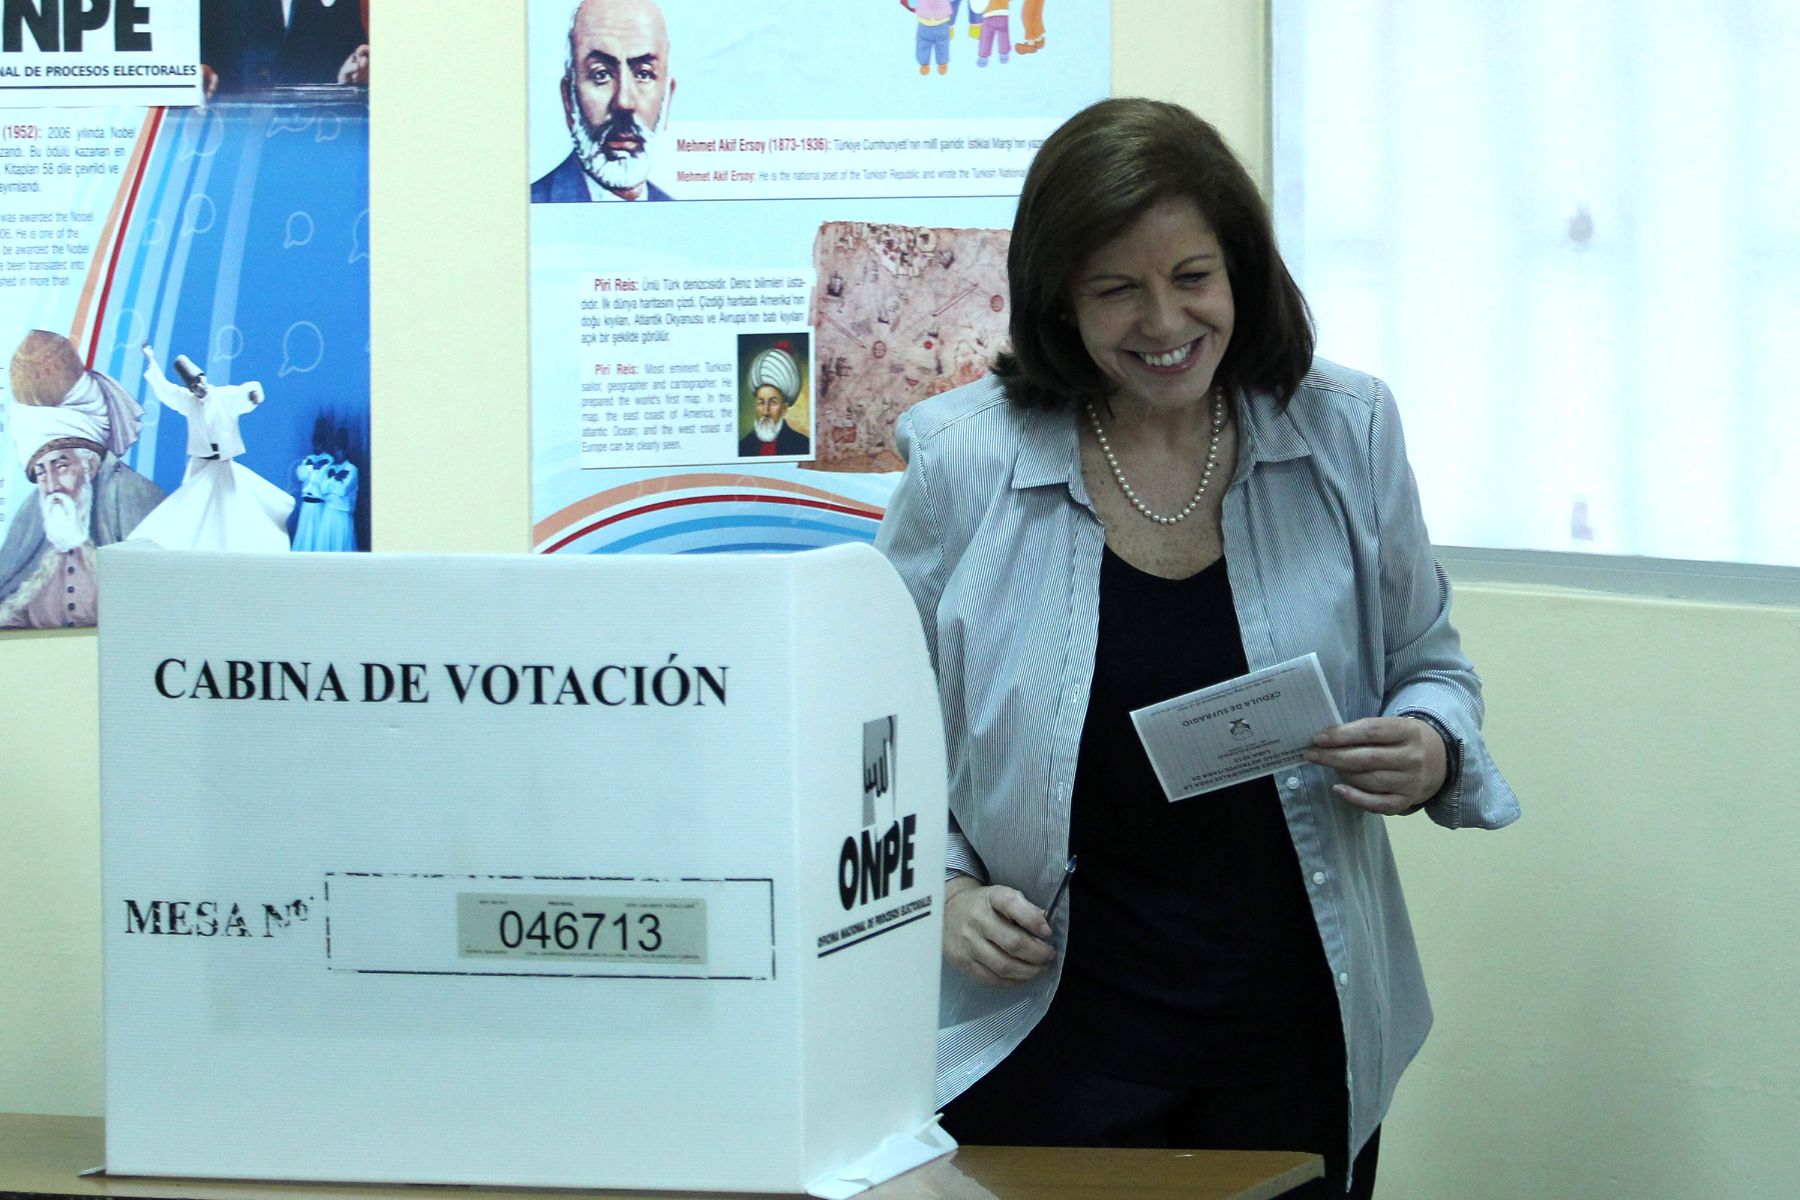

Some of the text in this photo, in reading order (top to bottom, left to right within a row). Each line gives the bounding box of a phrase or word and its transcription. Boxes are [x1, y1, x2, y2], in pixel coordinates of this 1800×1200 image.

[25, 66, 41, 77] DE
[46, 66, 109, 76] PROCESOS
[114, 65, 197, 76] ELECTORALES
[3, 125, 42, 142] (1952):
[48, 127, 71, 139] 2006
[111, 127, 136, 139] Nobel
[677, 139, 716, 151] Mehmet
[719, 139, 736, 151] Akif
[739, 139, 766, 154] Ersoy
[769, 138, 832, 154] (1873-1936):
[115, 148, 125, 157] en
[109, 165, 119, 175] ve
[677, 171, 710, 182] Mehmet
[714, 171, 728, 182] Akif
[56, 212, 68, 222] the
[71, 211, 94, 222] Nobel
[67, 228, 79, 239] the
[52, 244, 64, 255] the
[67, 244, 89, 254] Nobel
[594, 278, 611, 292] Piri
[615, 278, 639, 292] Reis:
[595, 364, 611, 375] Piri
[645, 364, 664, 375] Most
[705, 362, 732, 373] Turkish
[653, 380, 666, 390] and
[722, 378, 732, 388] He
[619, 396, 631, 406] the
[606, 411, 618, 422] the
[645, 411, 665, 420] coast
[721, 408, 732, 418] the
[644, 424, 657, 435] and
[662, 424, 673, 435] the
[700, 424, 720, 434] coast
[155, 653, 728, 707] CABINA DE VOTACIÓN
[1183, 708, 1229, 727] SUFRAGIO
[838, 814, 917, 911] ONPE
[123, 900, 253, 938] MESA
[500, 910, 662, 952] 046713
